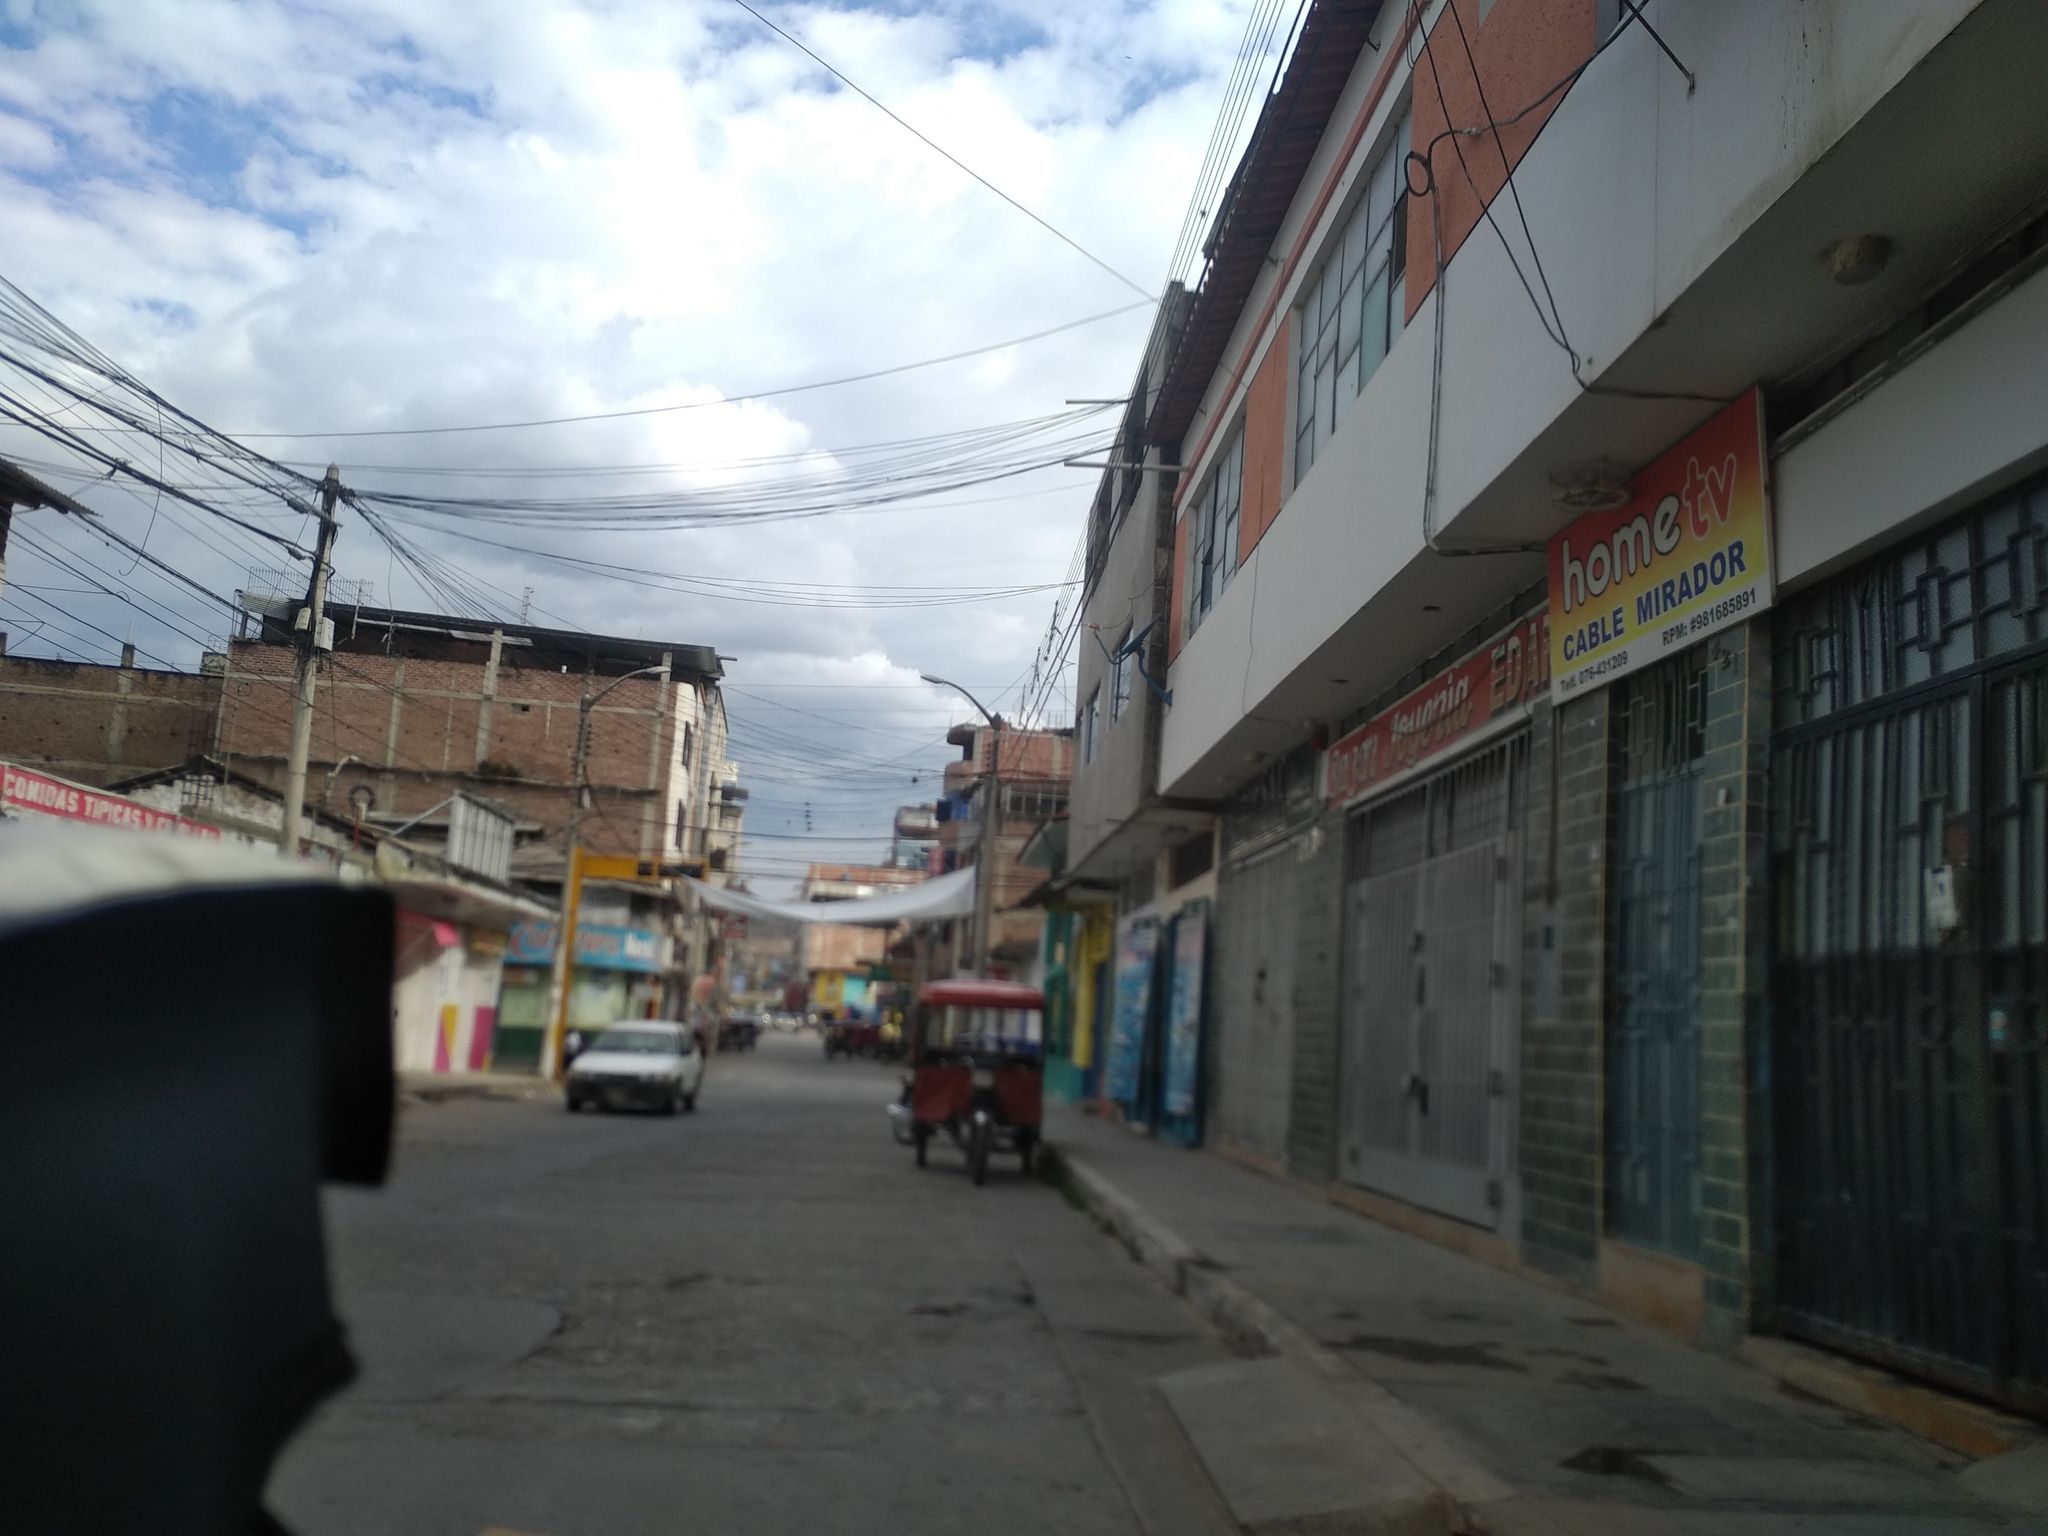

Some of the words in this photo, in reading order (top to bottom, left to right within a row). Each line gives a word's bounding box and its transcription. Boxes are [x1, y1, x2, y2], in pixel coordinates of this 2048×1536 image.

[1563, 497, 1681, 614] home
[1683, 454, 1738, 540] tv
[1564, 607, 1625, 661] CABLE
[1636, 540, 1746, 626] MIRADOR
[1662, 627, 1688, 647] RPM:
[1690, 588, 1757, 633] #981685891
[4, 774, 78, 812] COMIDAS
